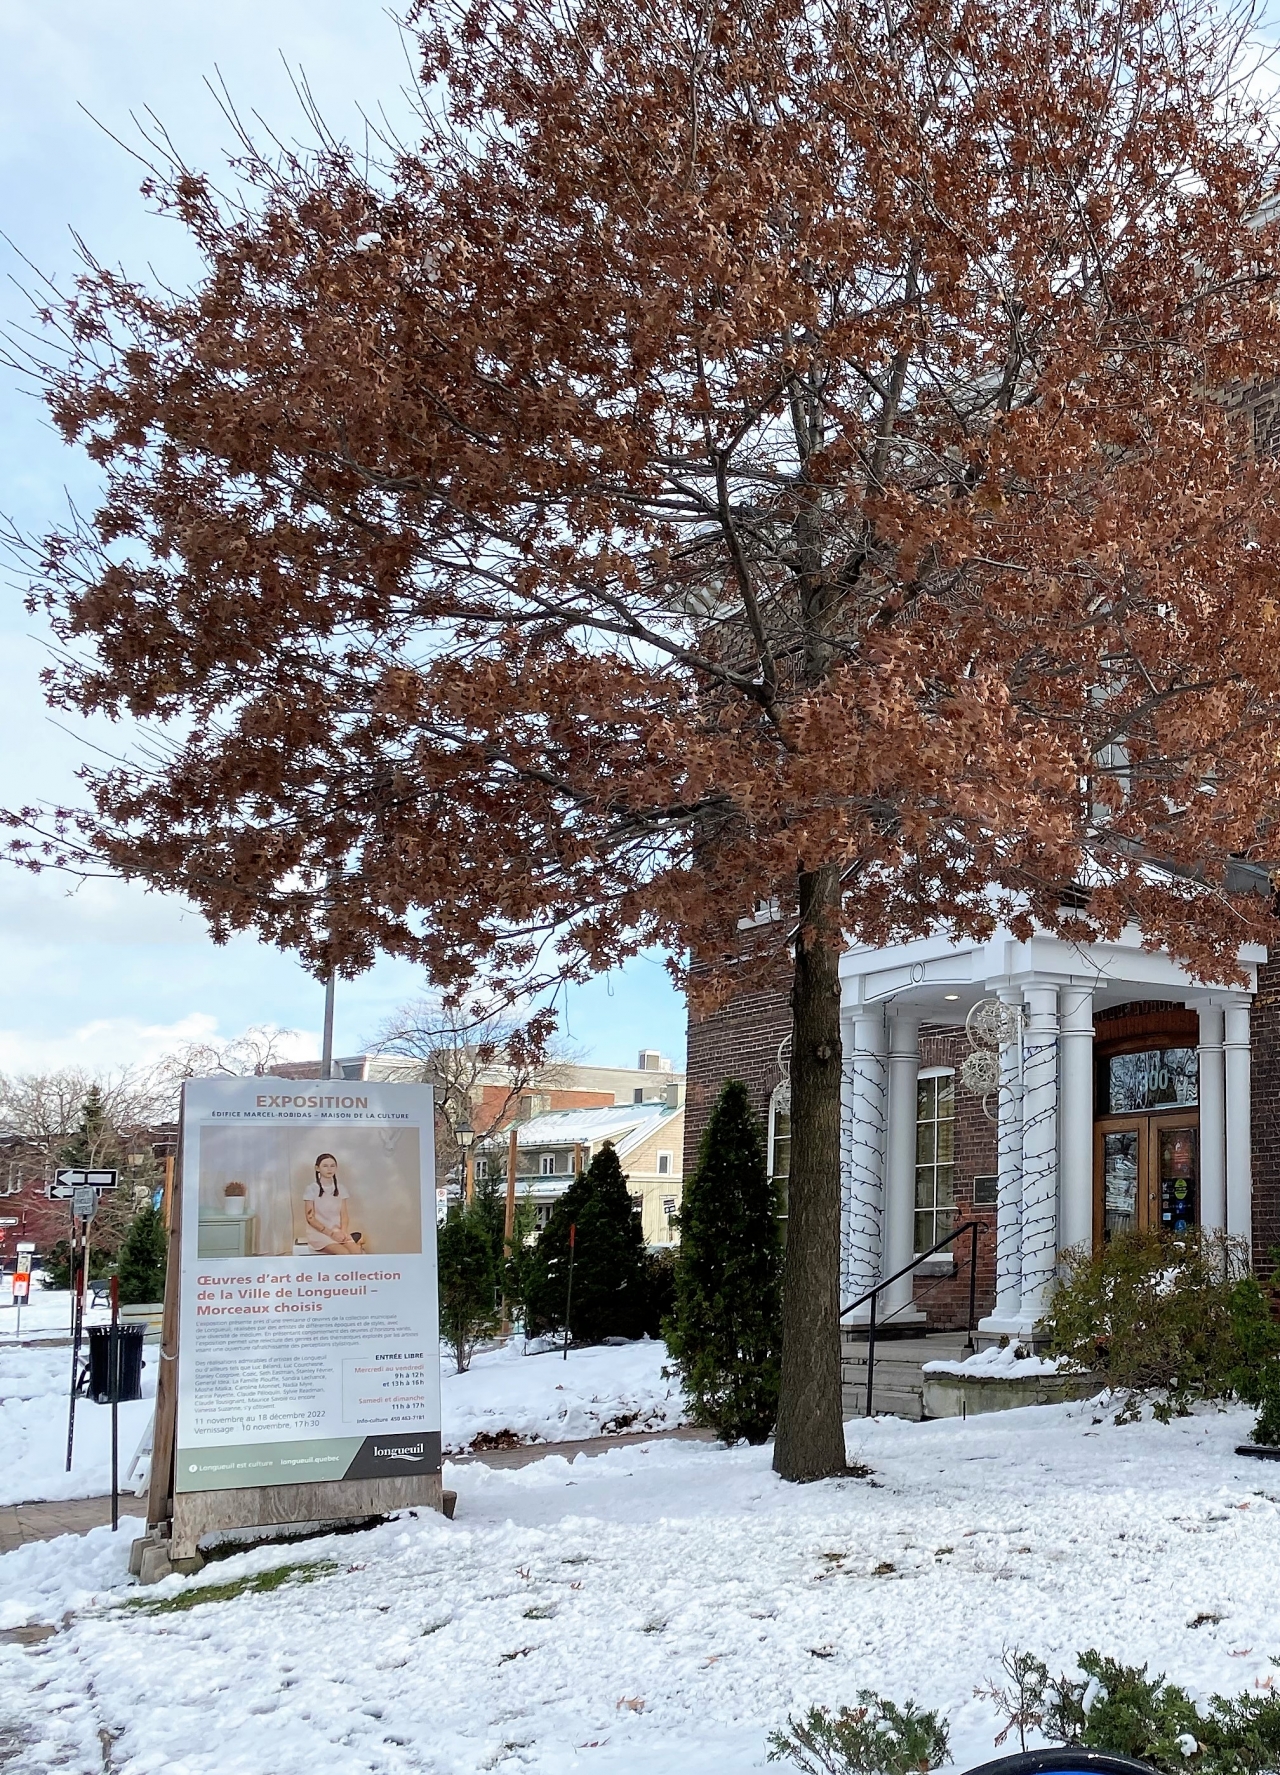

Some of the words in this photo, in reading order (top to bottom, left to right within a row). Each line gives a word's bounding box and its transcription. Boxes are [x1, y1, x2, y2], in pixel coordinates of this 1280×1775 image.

[256, 1096, 367, 1108] EXPOSITION
[197, 1276, 252, 1285] Œuvres
[296, 1273, 312, 1282] de
[318, 1272, 329, 1282] la
[334, 1271, 400, 1281] collection
[197, 1291, 215, 1301] de
[220, 1290, 233, 1300] la
[238, 1289, 270, 1298] Ville
[275, 1288, 292, 1298] de
[298, 1286, 366, 1299] Longueuil
[197, 1304, 269, 1315] Morceaux
[274, 1302, 322, 1313] choisis
[207, 1416, 243, 1424] novembre
[270, 1412, 305, 1420] décembre
[194, 1426, 234, 1434] Vernissage
[253, 1421, 291, 1430] novembre,
[374, 1444, 424, 1459] longueuil
[199, 1463, 235, 1472] Longueuil
[249, 1460, 273, 1468] culture
[281, 1456, 340, 1466] longueuil.quebec
